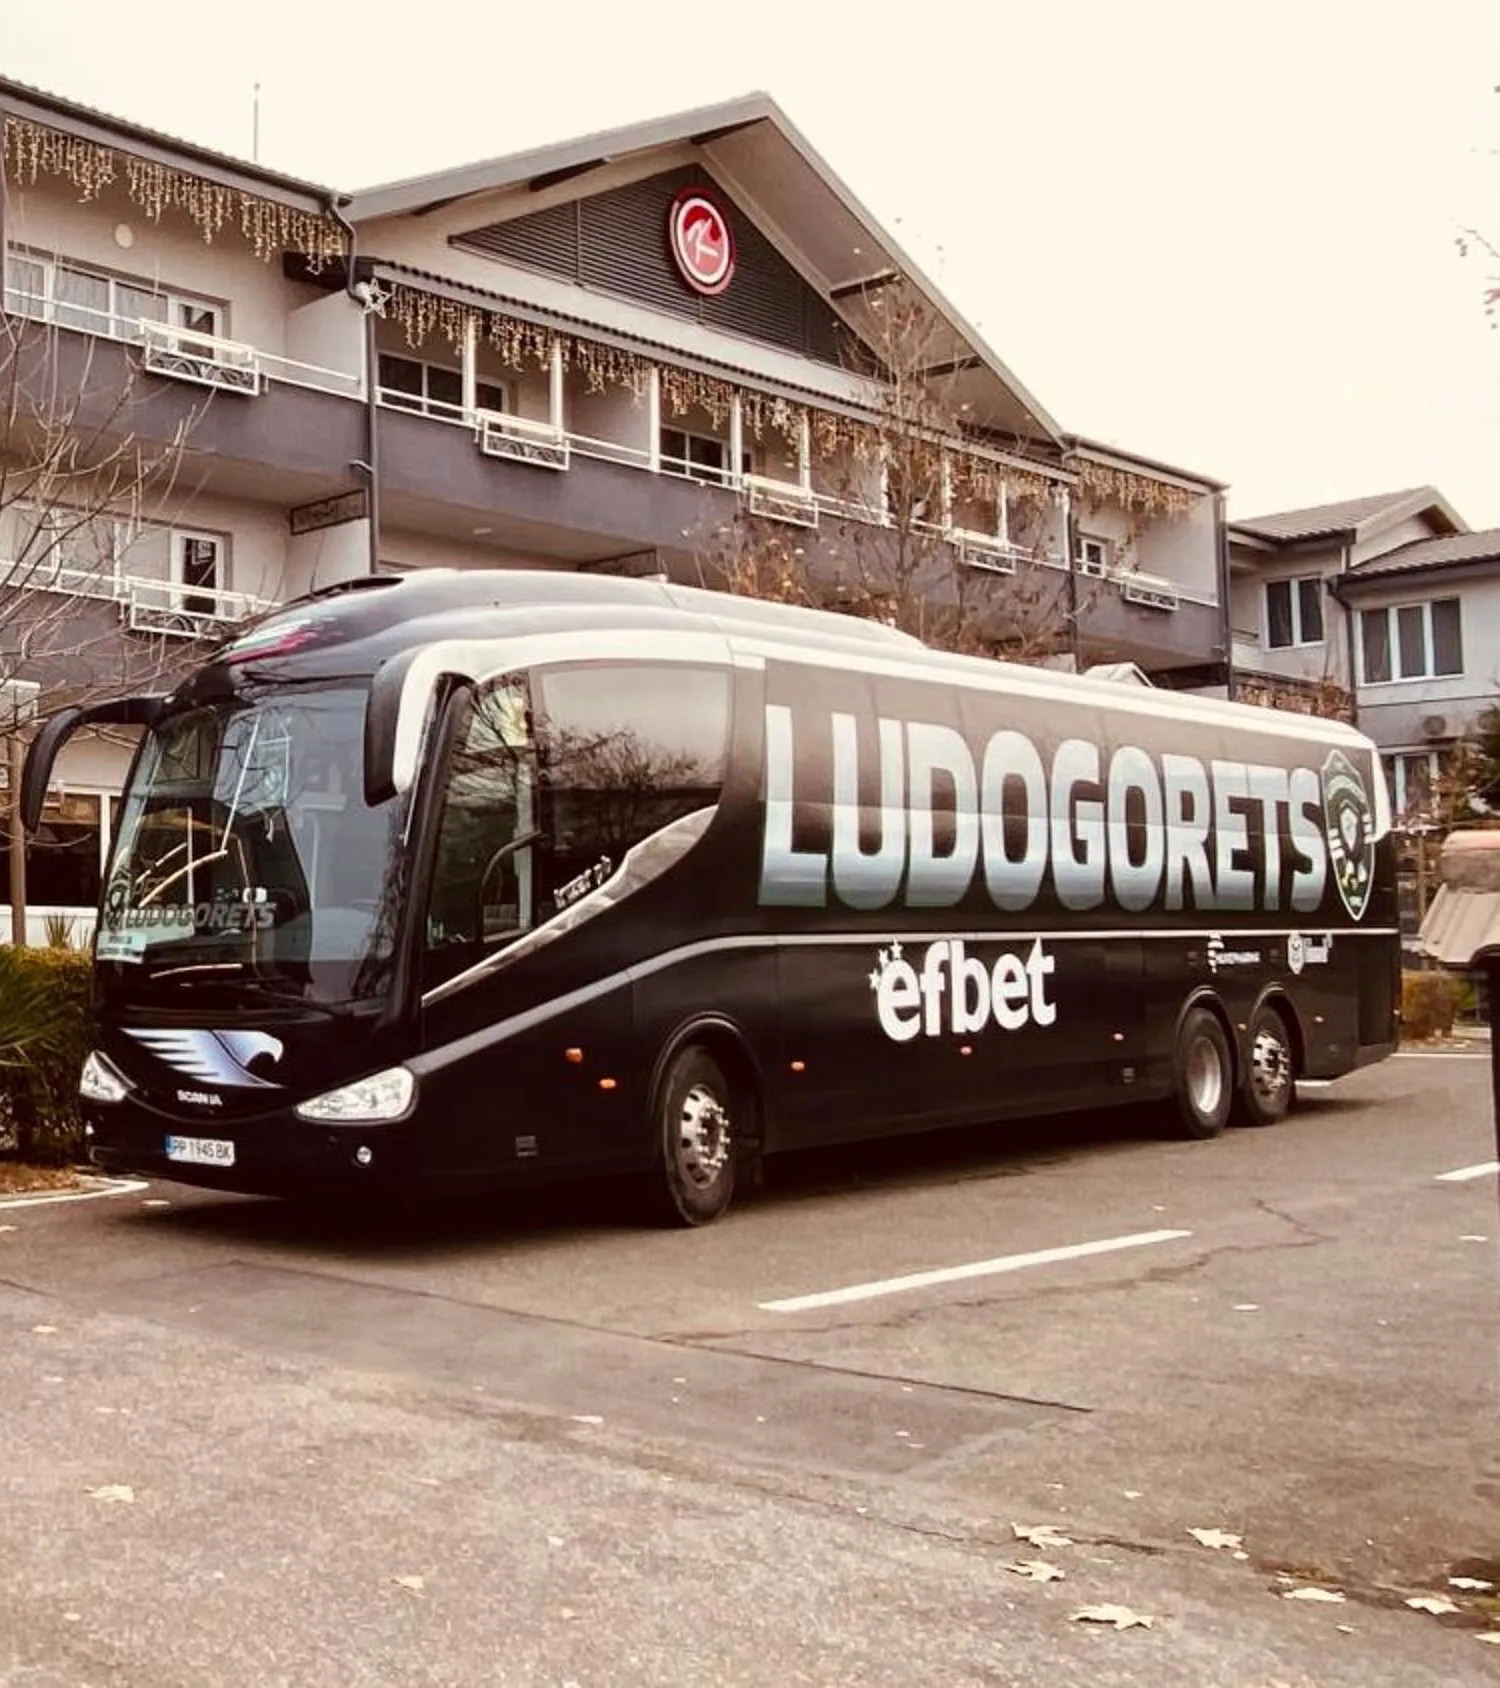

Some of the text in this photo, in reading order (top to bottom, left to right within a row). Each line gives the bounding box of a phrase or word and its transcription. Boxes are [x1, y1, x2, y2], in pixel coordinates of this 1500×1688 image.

[758, 704, 1327, 912] LUDOGORETS
[126, 902, 276, 929] LUDOGORETS
[877, 935, 1056, 1042] efbet
